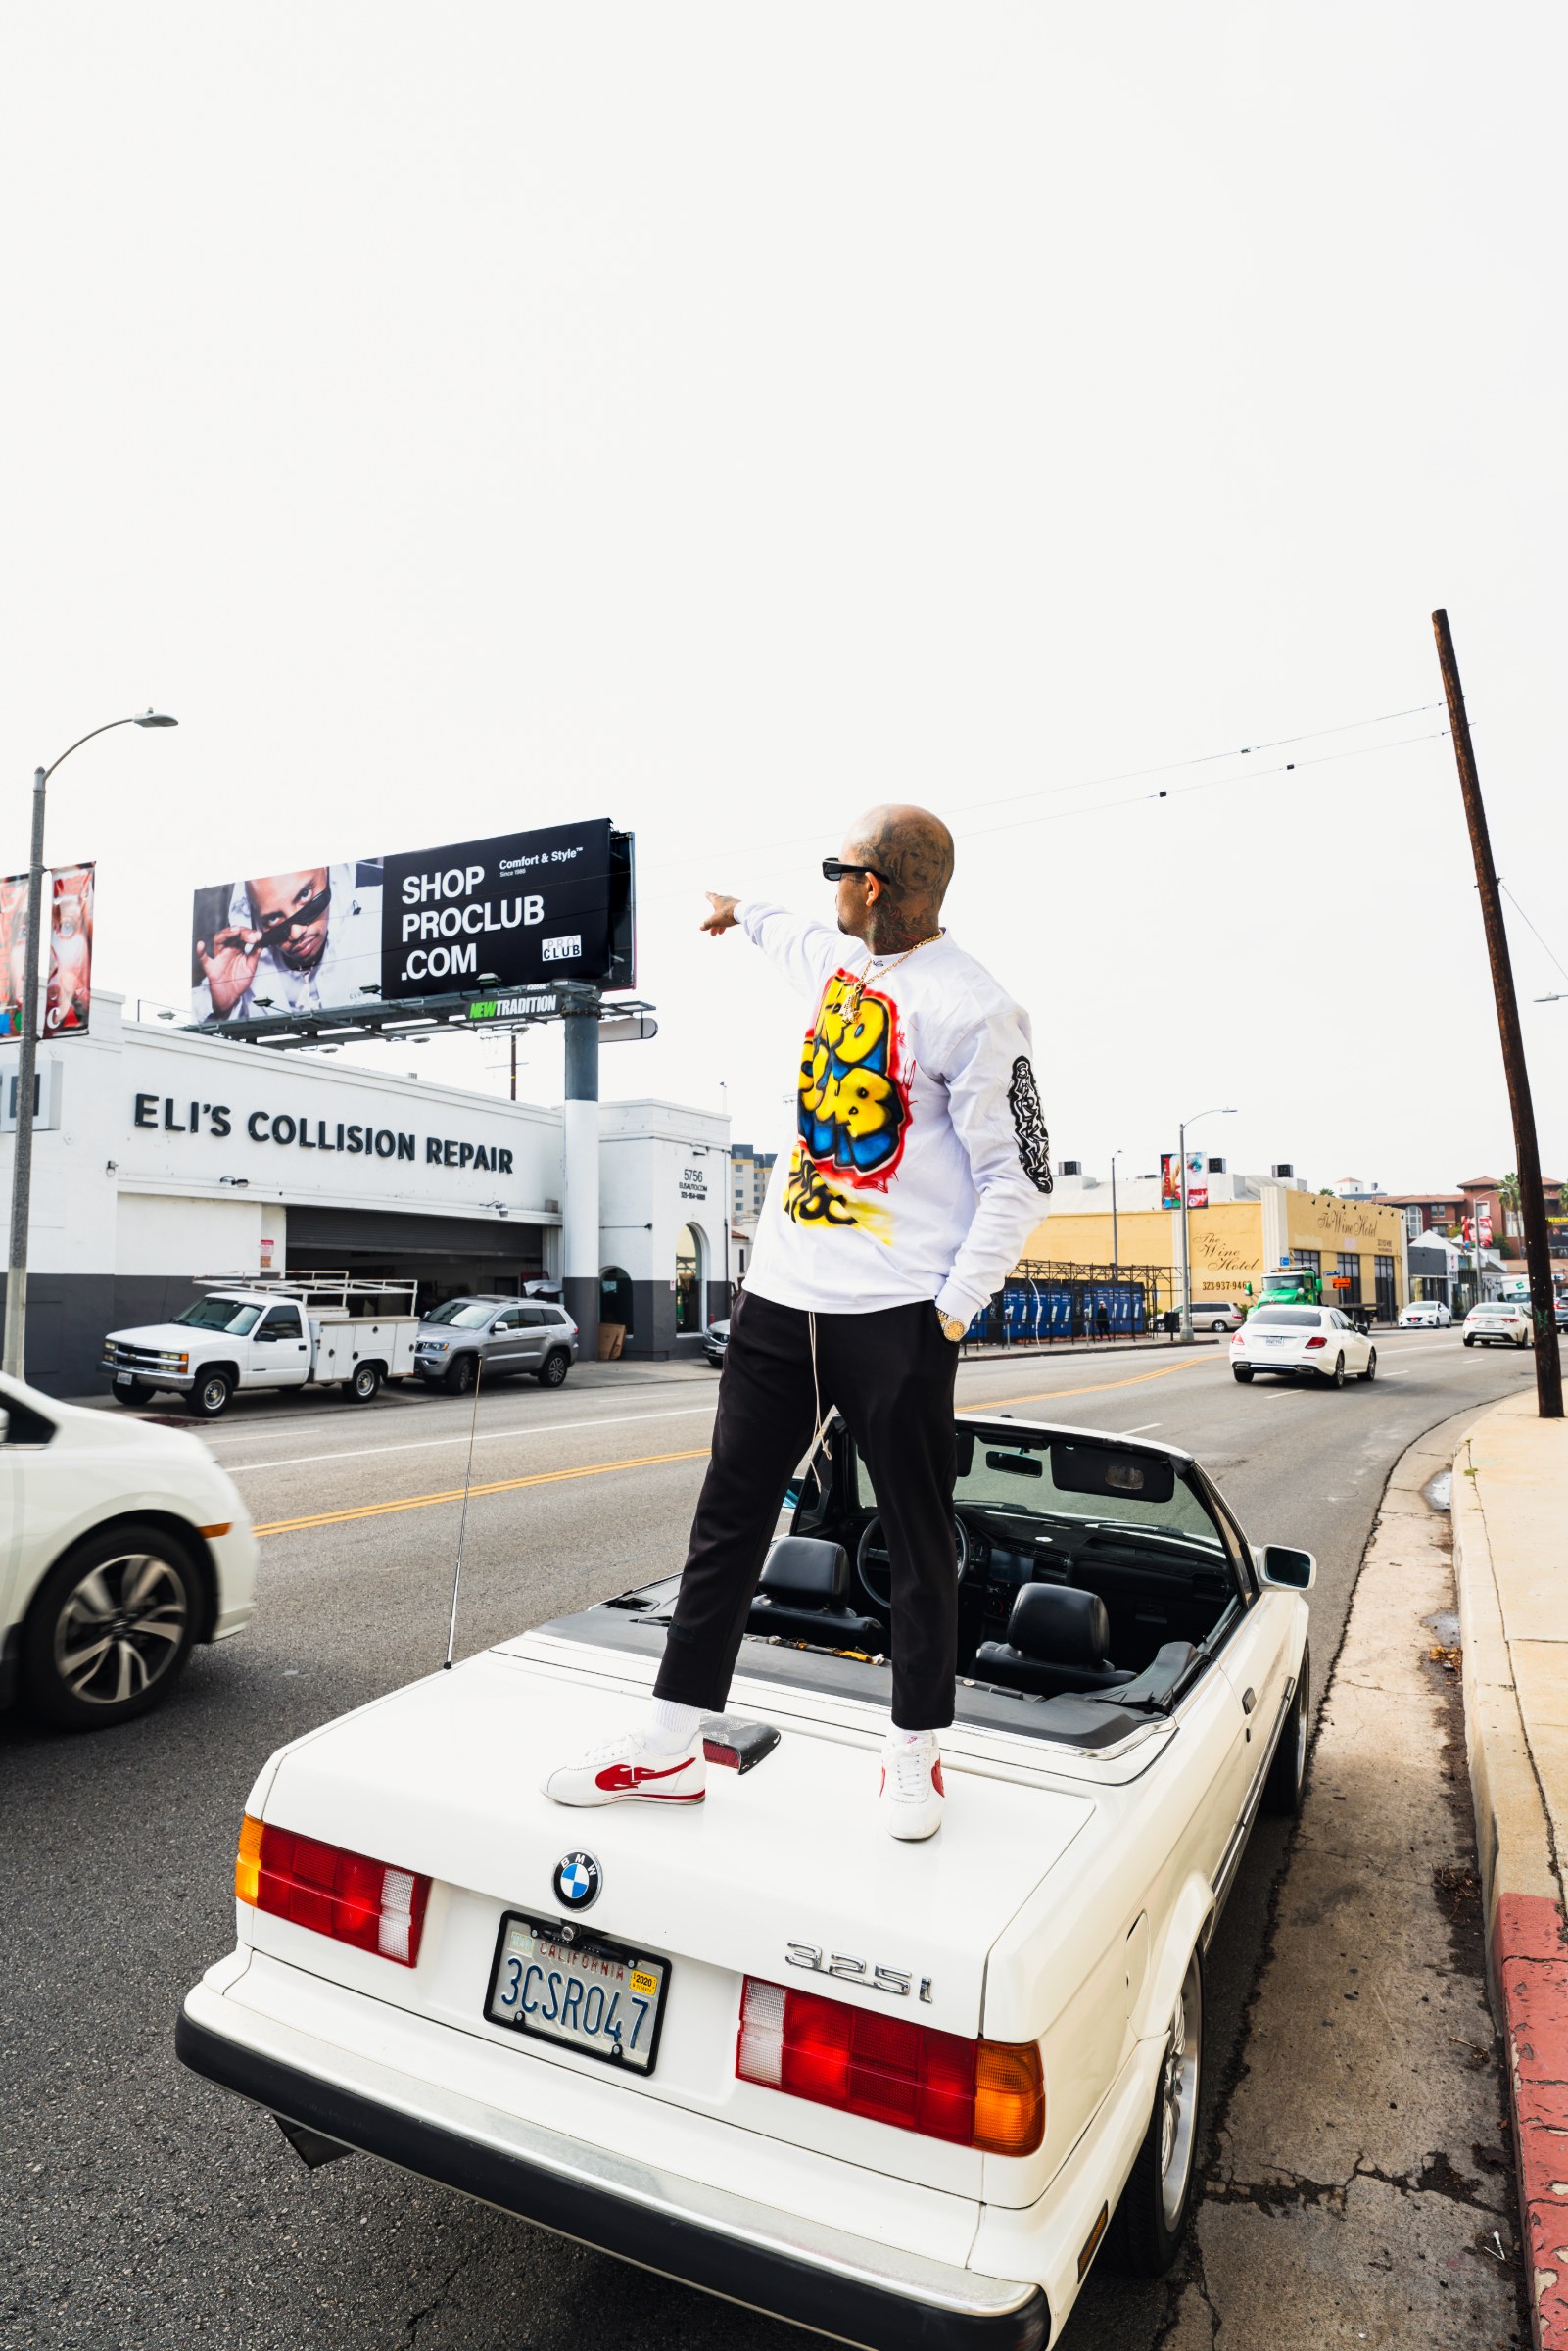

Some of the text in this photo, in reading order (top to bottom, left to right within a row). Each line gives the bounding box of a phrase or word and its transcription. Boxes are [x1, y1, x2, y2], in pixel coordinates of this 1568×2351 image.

[499, 856, 539, 870] Comfort
[541, 853, 549, 863] &
[402, 866, 485, 904] SHOP
[402, 895, 545, 942] PROCLUB
[401, 943, 477, 981] .COM
[544, 945, 580, 960] CLUB
[135, 1093, 513, 1175] ELI'S COLLISION REPAIR
[684, 1169, 703, 1182] 5756
[1318, 1210, 1378, 1237] The Wine Hotel
[1192, 1232, 1221, 1243] The
[1198, 1243, 1240, 1258] Wine
[1208, 1257, 1259, 1271] Hotel
[560, 1853, 597, 1876] BMW
[539, 1942, 624, 1981] CALIFORNIA
[784, 1940, 933, 2004] 325i
[635, 1974, 653, 1988] 2020
[500, 1957, 650, 2049] 3CSR047
